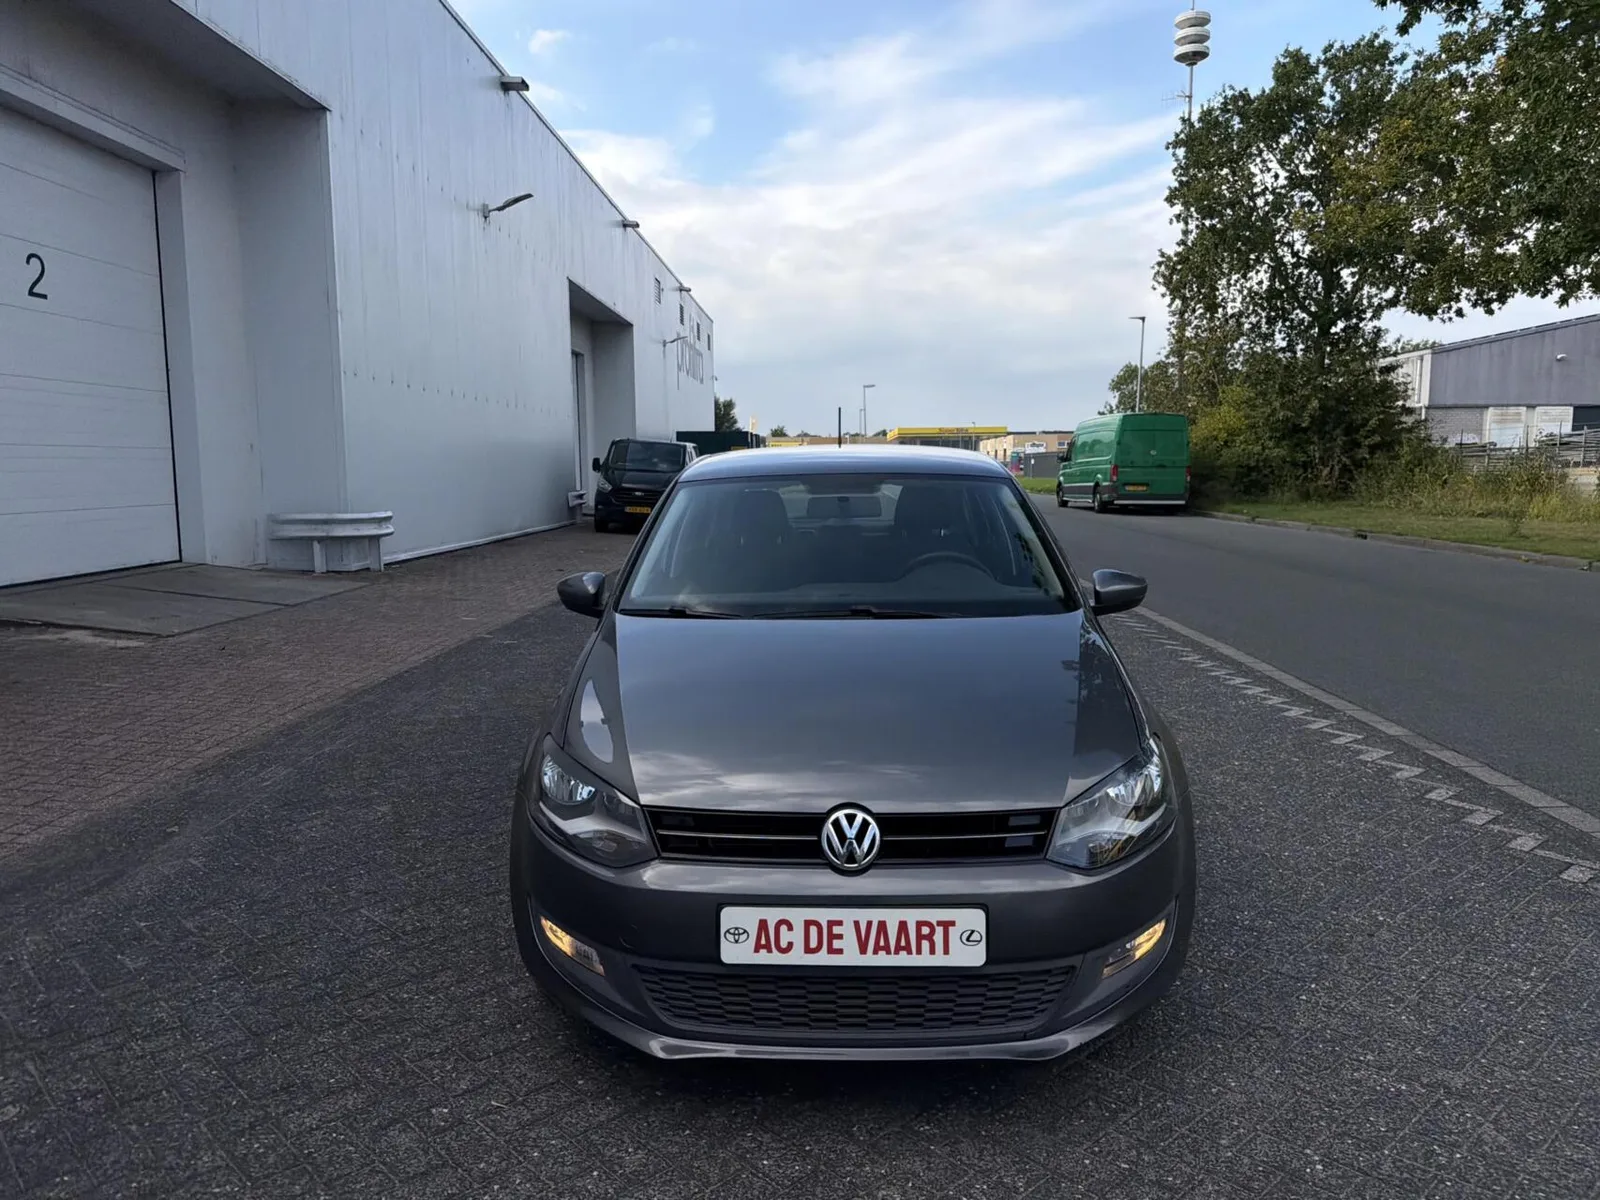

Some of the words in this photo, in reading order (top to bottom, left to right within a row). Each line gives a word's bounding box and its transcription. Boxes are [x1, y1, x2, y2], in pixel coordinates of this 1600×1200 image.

[25, 252, 48, 300] 2
[753, 918, 794, 955] AC
[803, 919, 844, 955] DE
[853, 920, 956, 956] VAART
